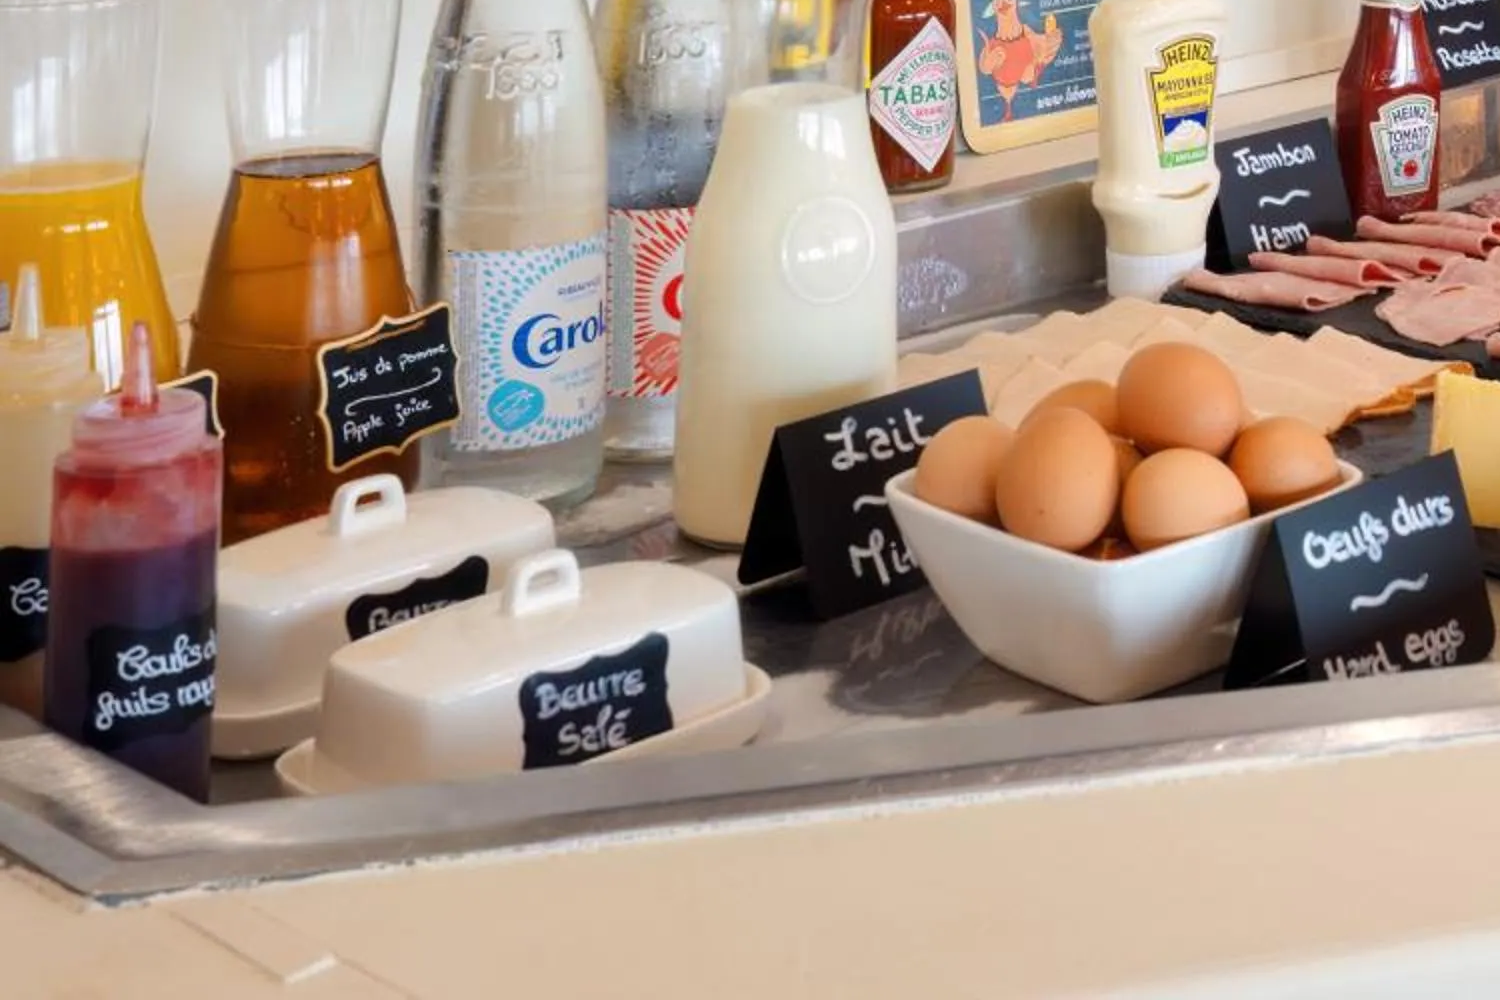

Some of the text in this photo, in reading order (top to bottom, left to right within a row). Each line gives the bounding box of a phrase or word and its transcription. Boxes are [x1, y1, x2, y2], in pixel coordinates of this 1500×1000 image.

[1165, 42, 1209, 67] HEINZ
[879, 77, 955, 106] TABAS
[1391, 105, 1427, 123] HEINZ
[1232, 142, 1317, 177] Jambon
[511, 300, 607, 369] Carol
[332, 365, 369, 389] Jus
[375, 356, 393, 375] de
[342, 398, 433, 443] Apple juice
[824, 407, 932, 471] Lait
[1391, 494, 1454, 537] durs
[116, 633, 202, 681] Coulis
[1323, 619, 1465, 681] Hard eggs
[95, 684, 171, 731] fruits
[534, 667, 647, 720] Beurre
